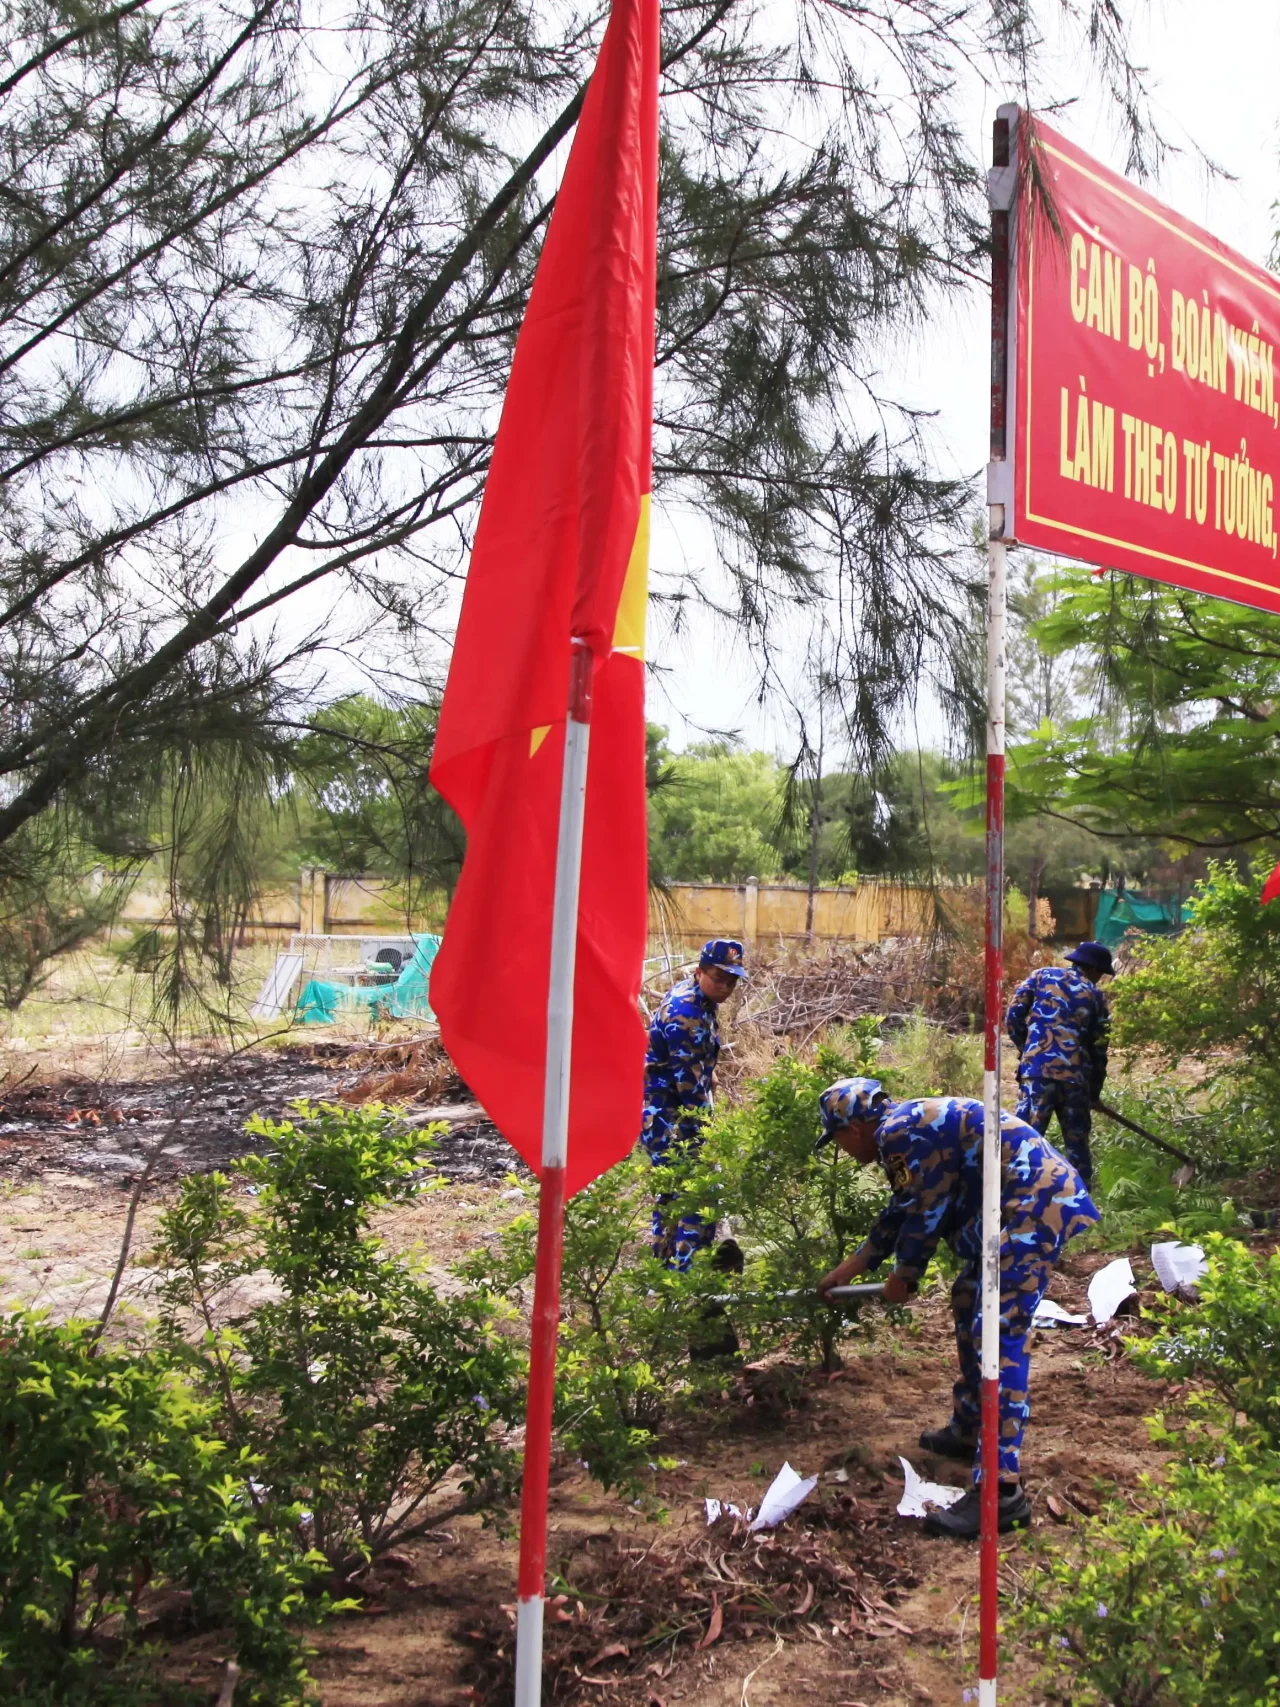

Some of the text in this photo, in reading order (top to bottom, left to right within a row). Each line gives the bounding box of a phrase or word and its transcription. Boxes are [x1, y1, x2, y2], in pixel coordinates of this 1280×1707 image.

[1070, 225, 1121, 341] CÁN
[1128, 257, 1165, 378] BỘ,
[1171, 289, 1227, 394] ĐOÀN
[1230, 321, 1279, 428] VIÊN,
[1060, 375, 1115, 493] LÀM
[1121, 413, 1177, 514] THEO
[1183, 440, 1211, 525] TƯ
[1213, 437, 1278, 558] TƯỞNG,
